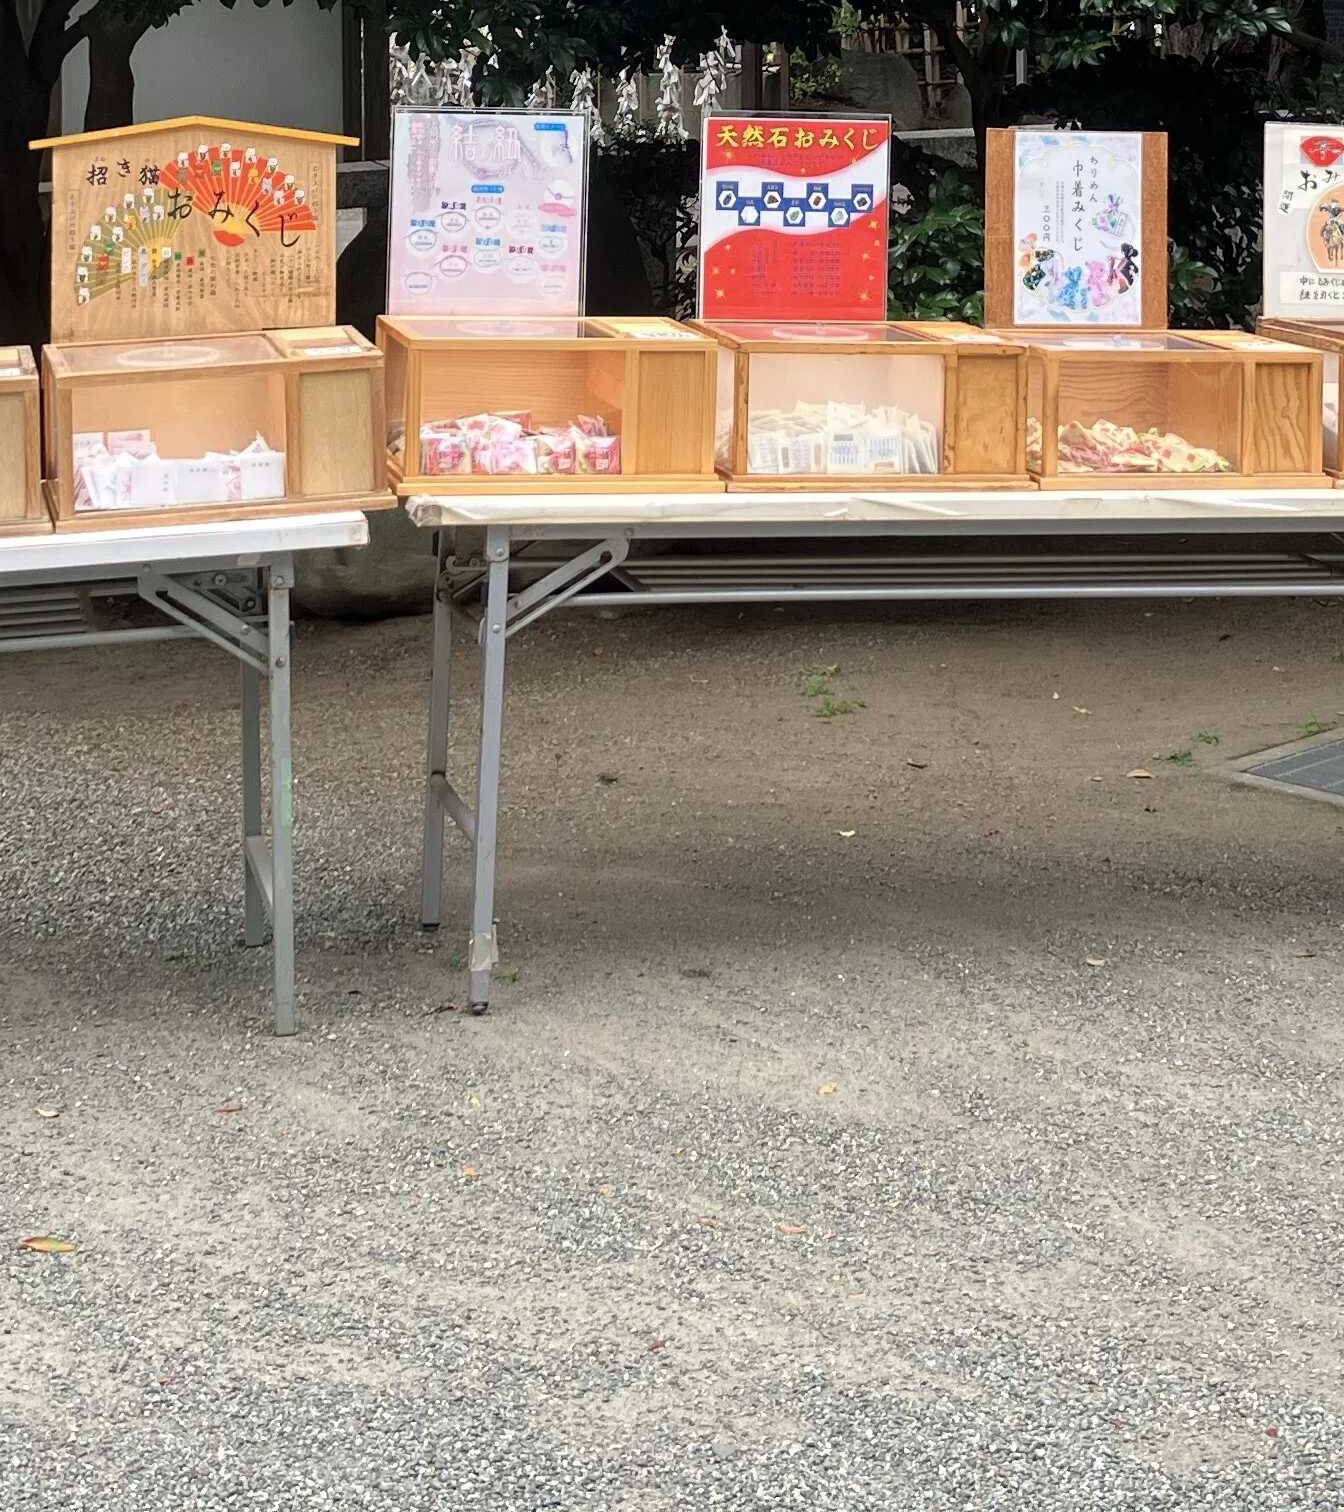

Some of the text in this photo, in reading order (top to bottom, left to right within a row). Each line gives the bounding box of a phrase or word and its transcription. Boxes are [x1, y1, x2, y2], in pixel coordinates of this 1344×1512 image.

[716, 124, 879, 150] 天然石おみくじ
[86, 158, 161, 186] 招き猫
[167, 187, 301, 248] おみくじ
[1071, 160, 1086, 252] 巾着みくじ
